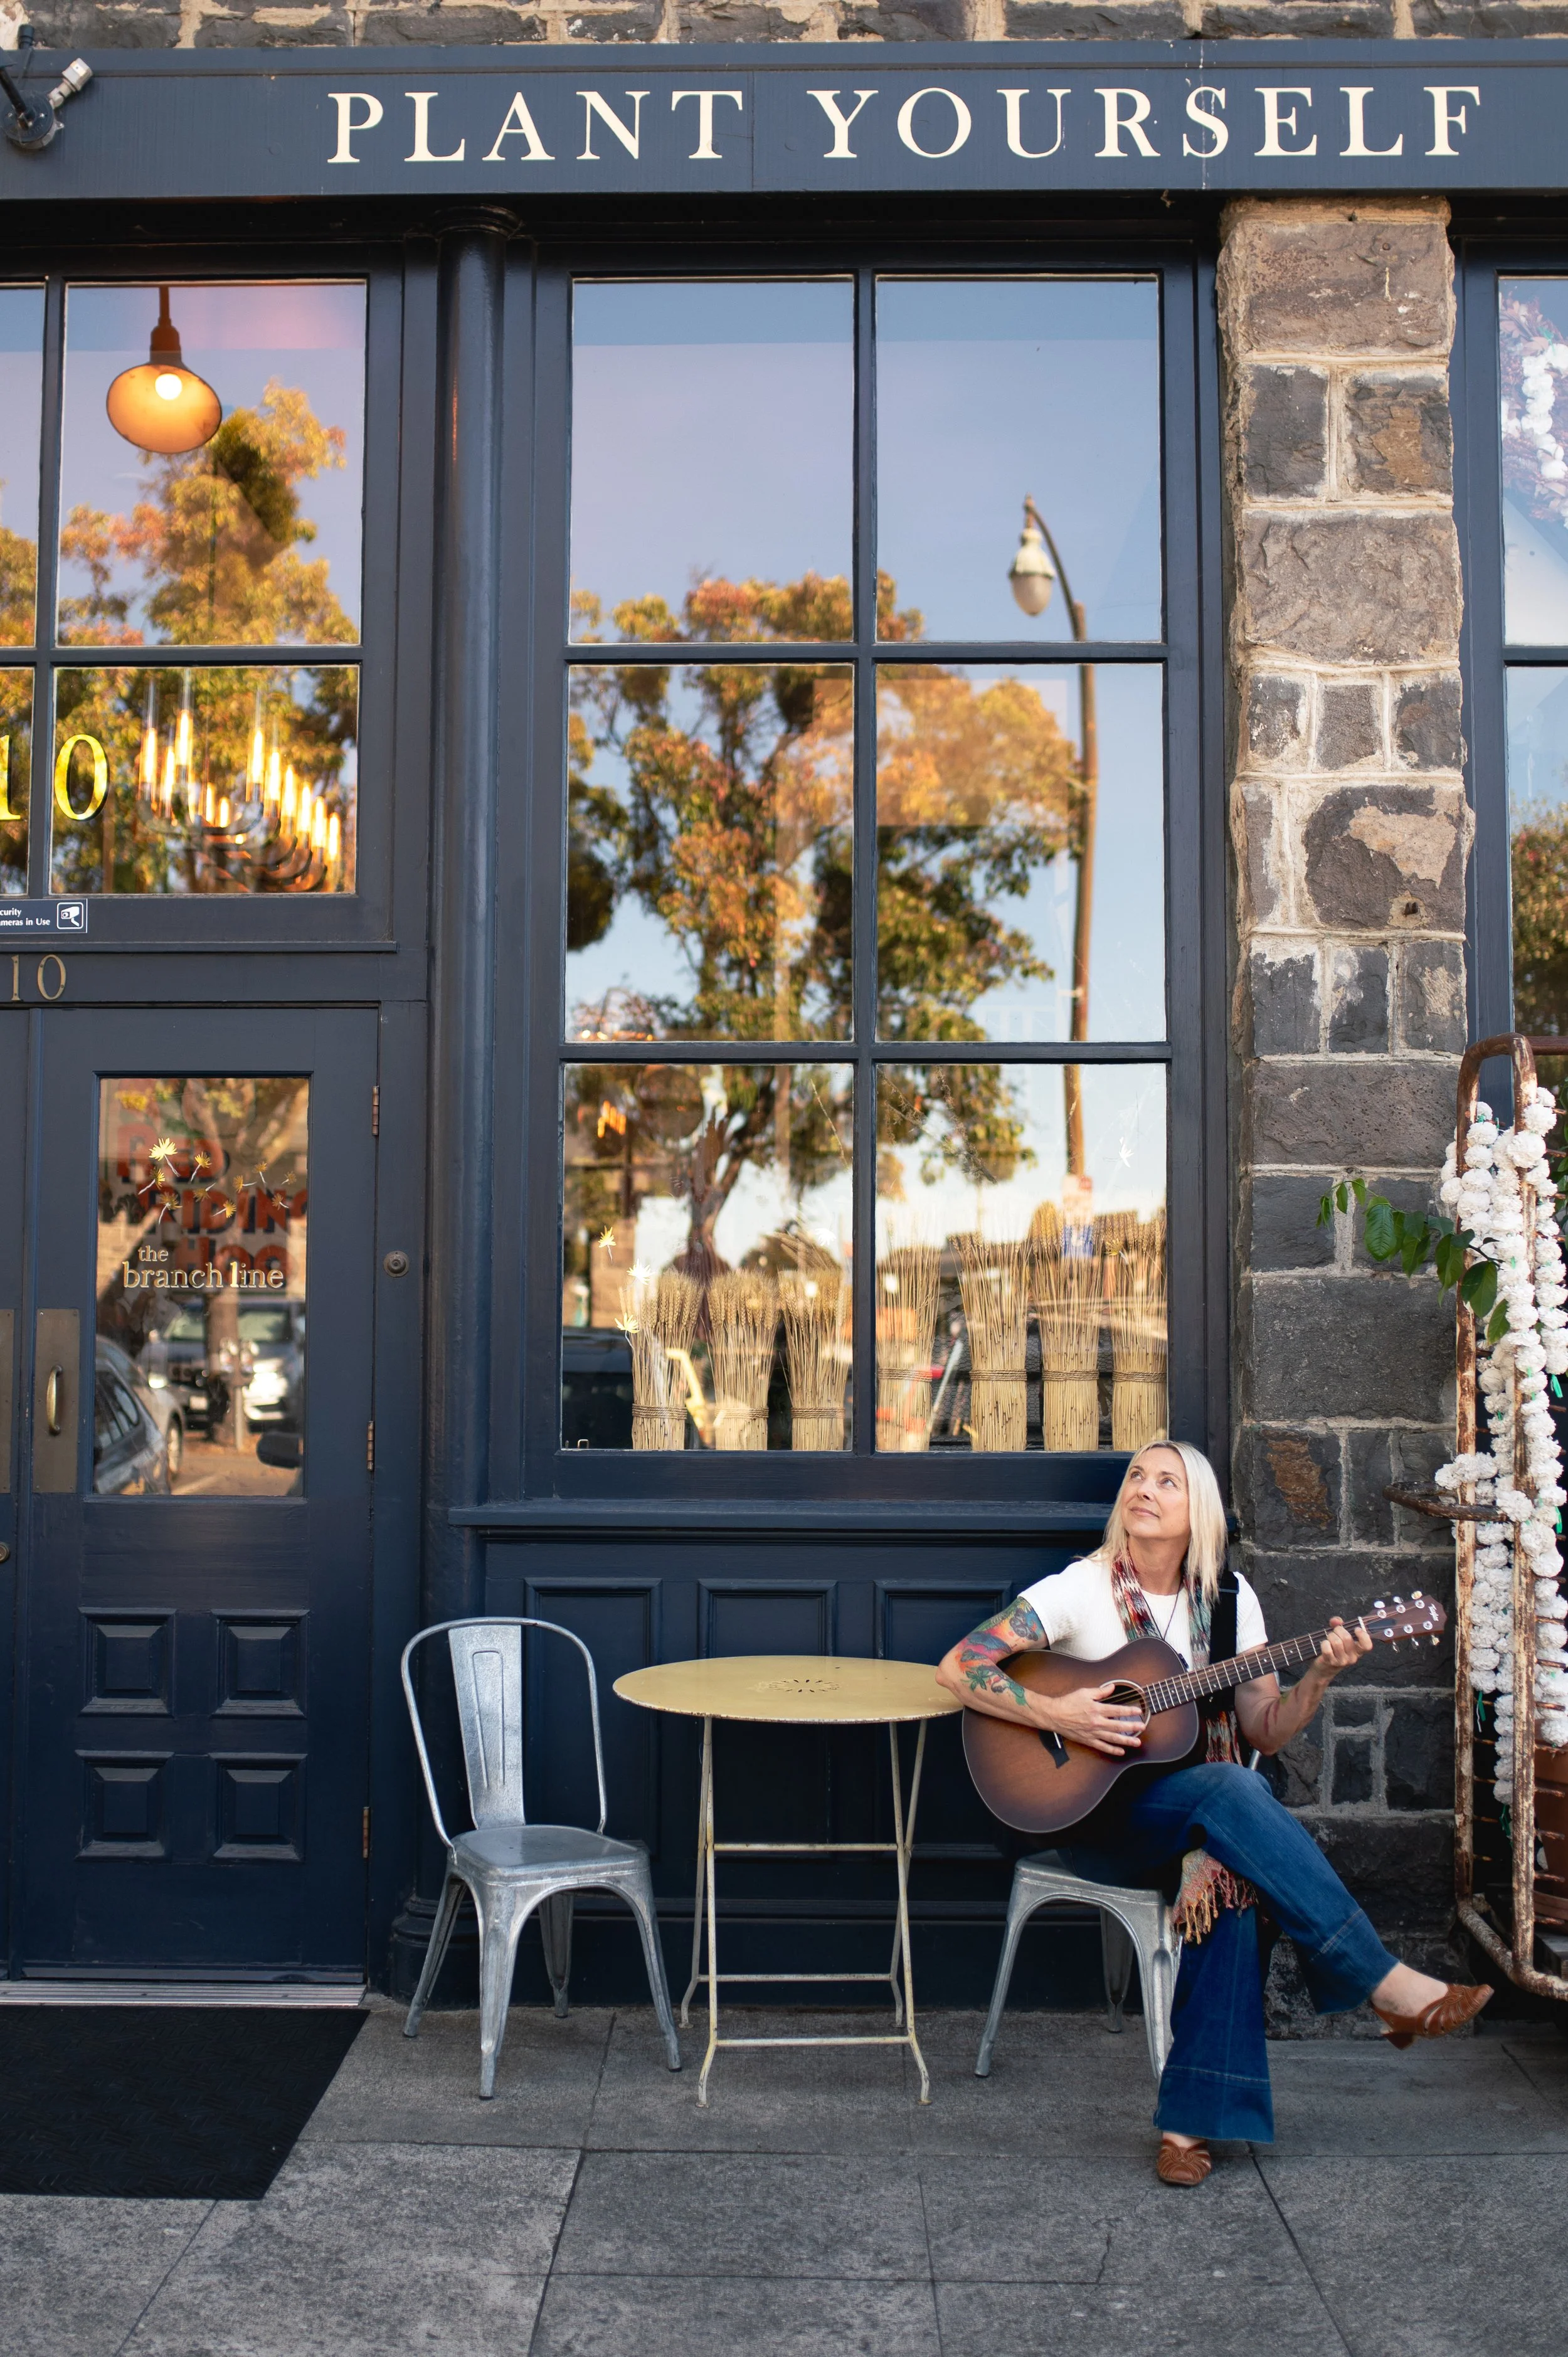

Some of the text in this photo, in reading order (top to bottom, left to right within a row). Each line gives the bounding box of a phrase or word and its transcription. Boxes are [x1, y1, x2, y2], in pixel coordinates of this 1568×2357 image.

[327, 86, 1481, 163] PLANT YOURSELF
[26, 917, 33, 926] in
[36, 918, 51, 926] Use
[11, 954, 66, 1001] 10
[138, 1245, 169, 1262] the
[122, 1261, 284, 1289] branch line
